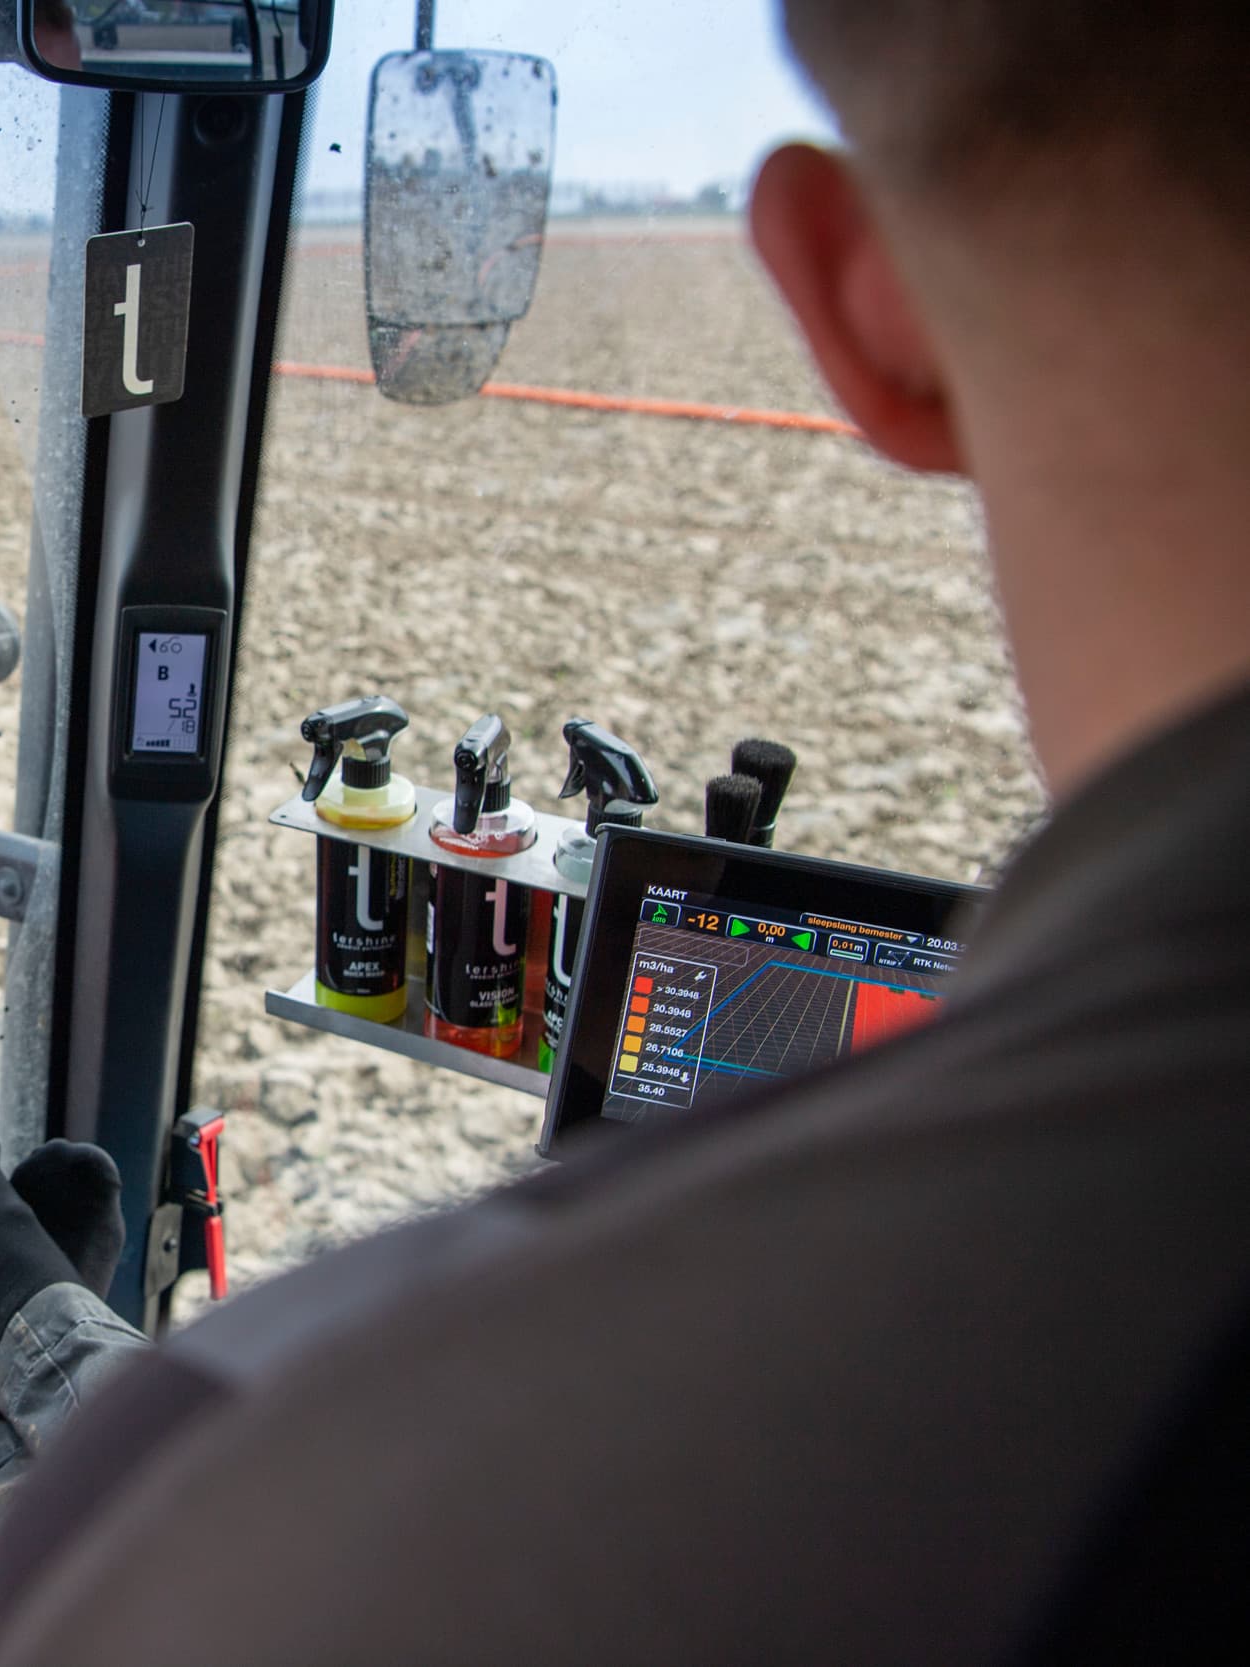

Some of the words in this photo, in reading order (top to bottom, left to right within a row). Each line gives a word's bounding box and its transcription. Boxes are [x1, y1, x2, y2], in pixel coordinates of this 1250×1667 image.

[114, 263, 154, 395] t
[157, 665, 169, 680] B
[169, 698, 197, 719] 52
[348, 845, 383, 931] t
[647, 885, 688, 901] KAART
[485, 878, 516, 957] t
[651, 916, 667, 924] AUTO
[687, 913, 719, 931] -12
[757, 923, 786, 938] 0,00
[807, 916, 857, 934] sleepslang
[859, 925, 902, 941] bemester
[764, 936, 775, 944] m
[349, 961, 380, 971] APEX
[639, 960, 675, 974] m3/ha
[913, 957, 932, 968] RTK
[478, 986, 515, 1001] VISION
[665, 987, 701, 1000] 30.3948
[653, 1003, 692, 1018] 30.3948
[649, 1023, 688, 1038] 28.5527
[645, 1043, 684, 1057] 26.7106
[642, 1062, 680, 1077] 25.3948
[637, 1084, 666, 1097] 35.40
